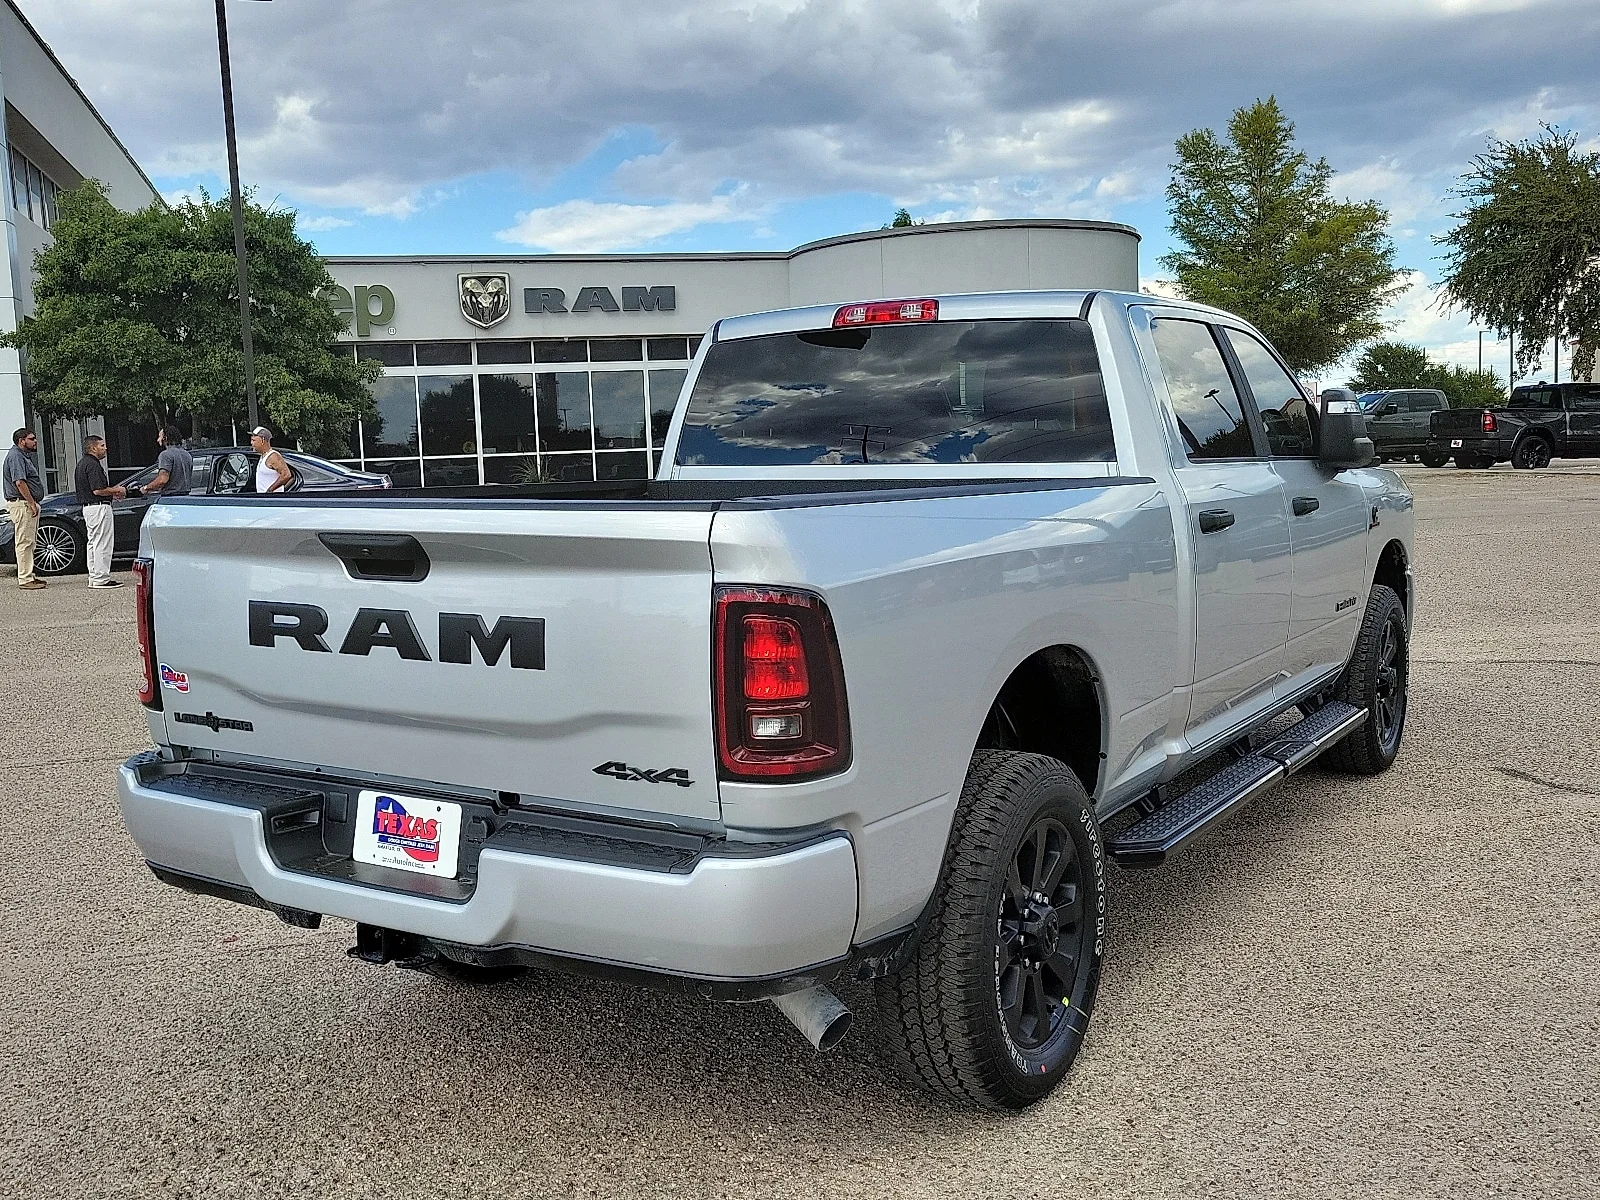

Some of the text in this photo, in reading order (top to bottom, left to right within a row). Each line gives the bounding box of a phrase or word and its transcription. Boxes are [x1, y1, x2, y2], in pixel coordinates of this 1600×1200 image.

[523, 285, 676, 313] RAM
[249, 599, 546, 671] RAM
[174, 711, 254, 732] LONE STAR
[377, 811, 438, 840] TEXAS
